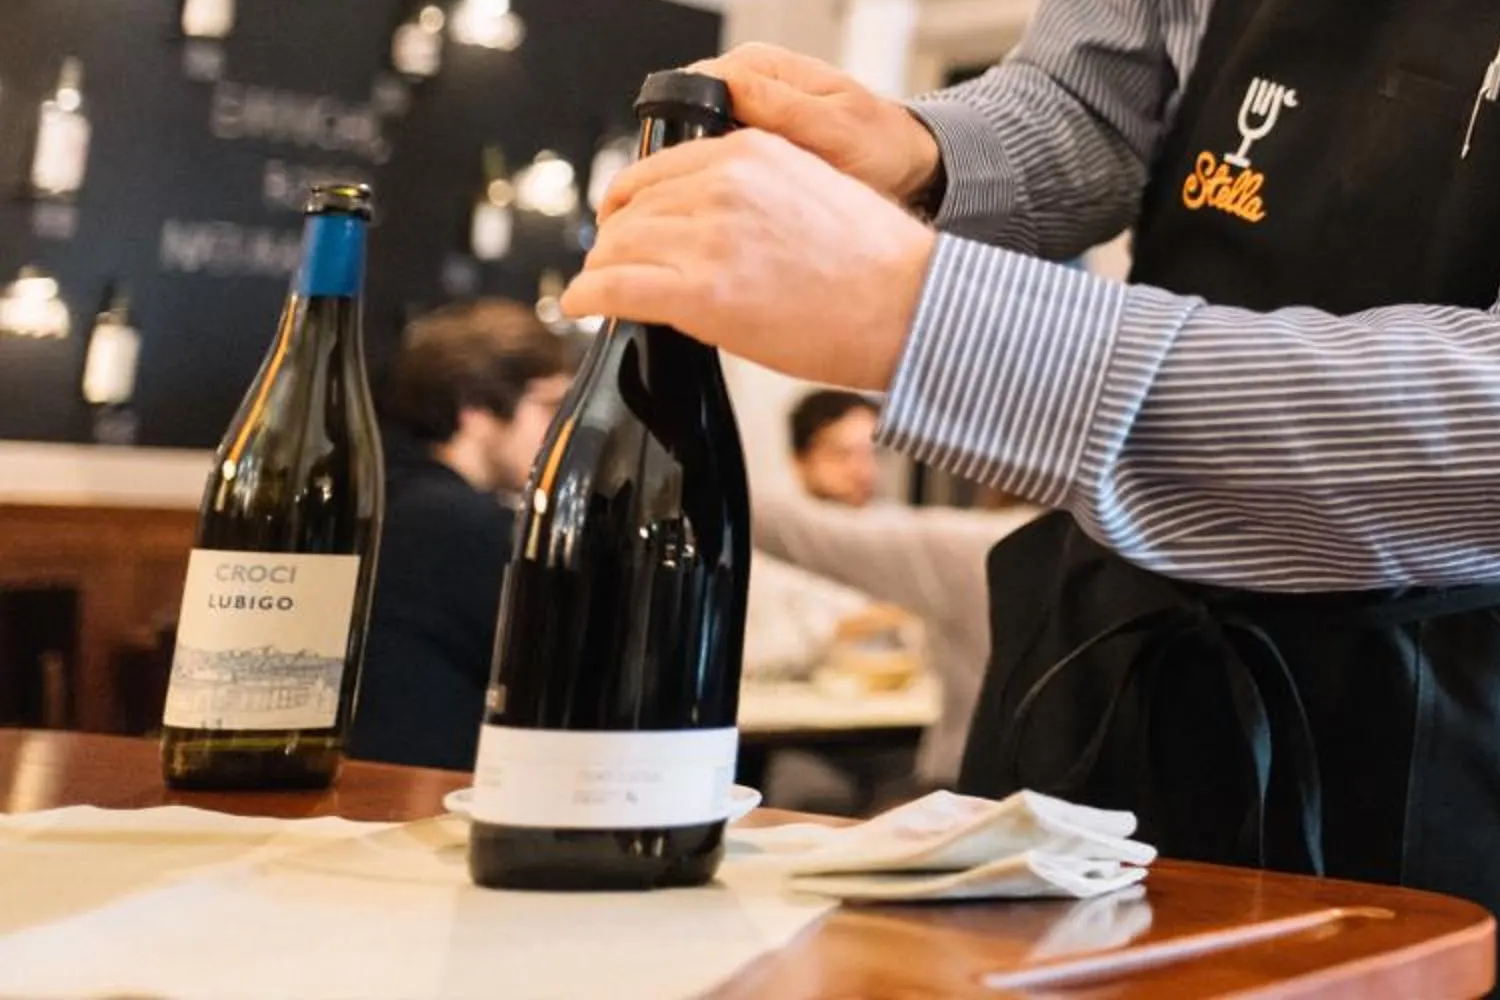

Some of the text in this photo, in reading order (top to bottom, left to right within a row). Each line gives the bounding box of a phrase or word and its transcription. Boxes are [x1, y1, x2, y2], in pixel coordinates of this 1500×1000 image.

[1183, 151, 1266, 222] Stella
[215, 563, 297, 584] CROCI
[208, 594, 294, 611] LUBIGO
